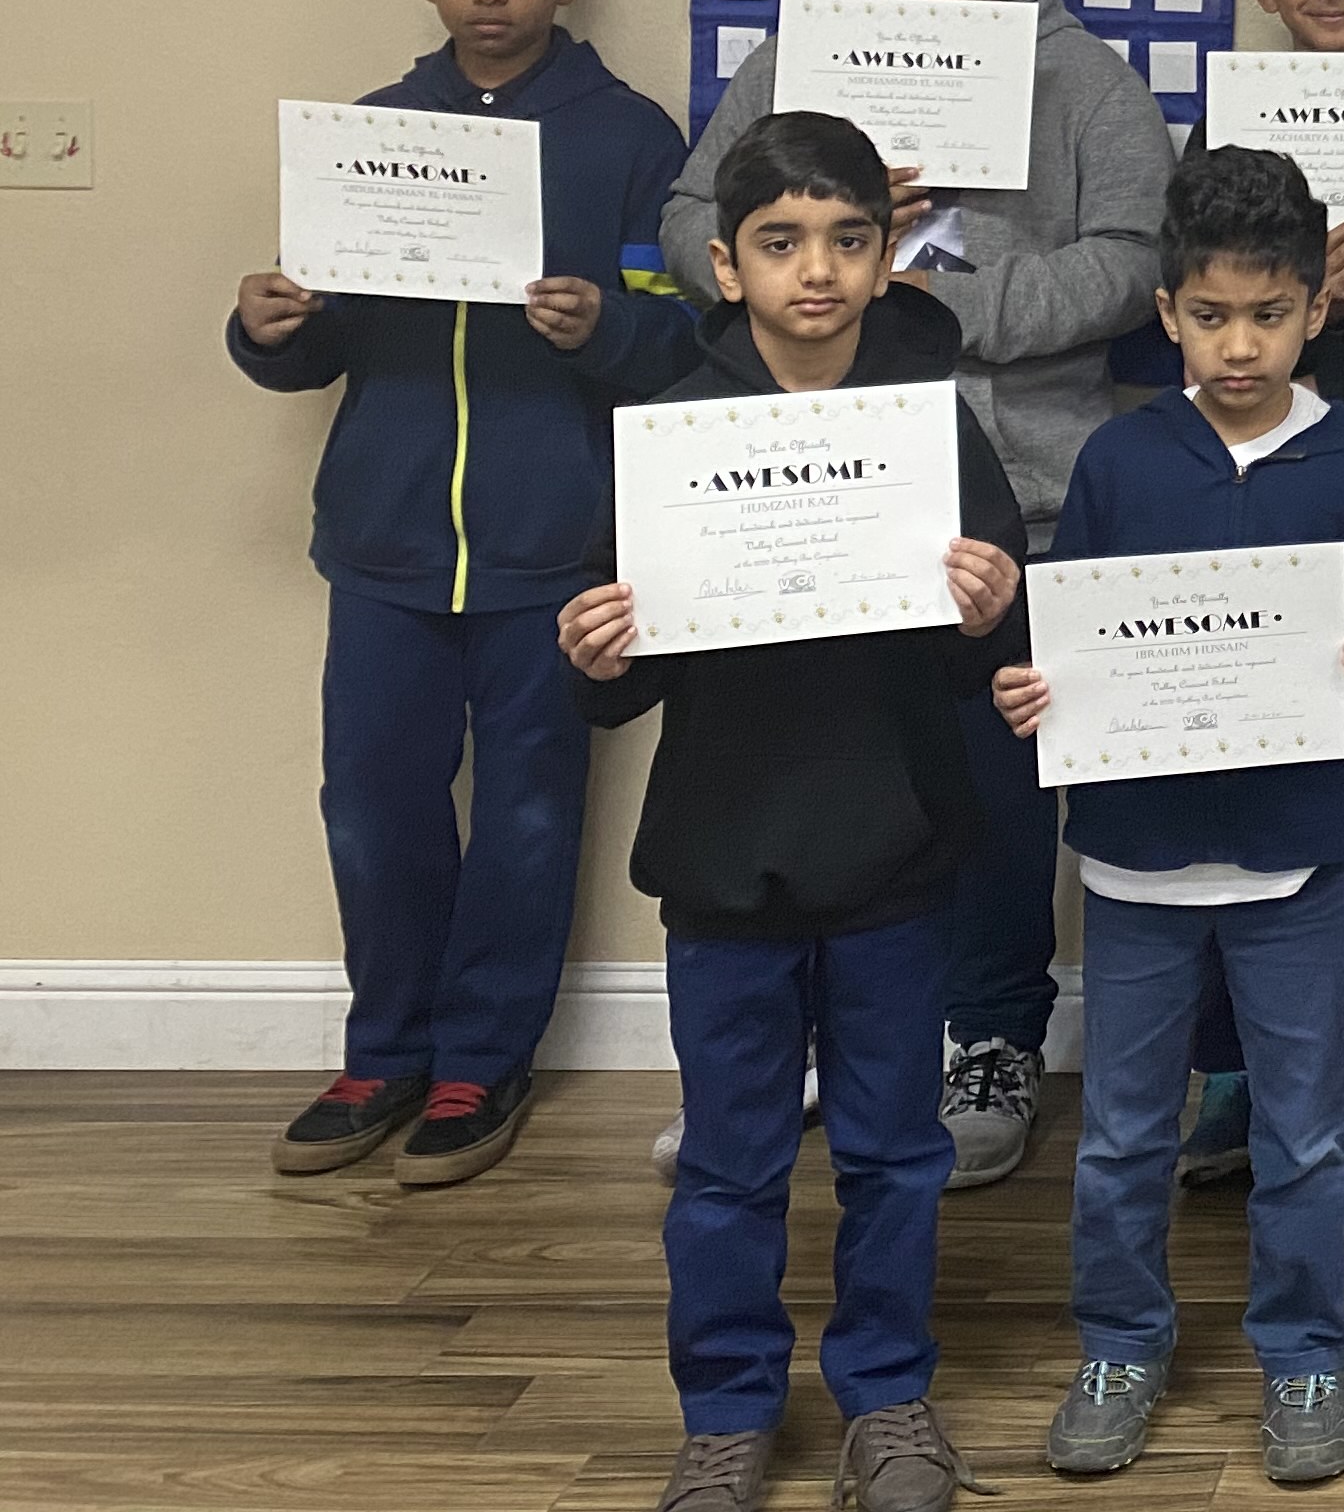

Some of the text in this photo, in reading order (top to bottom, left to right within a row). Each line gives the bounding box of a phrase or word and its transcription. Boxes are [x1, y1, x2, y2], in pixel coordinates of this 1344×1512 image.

[842, 49, 971, 70] AWESOME
[347, 160, 478, 185] AWESOME
[704, 458, 873, 494] AWESOME
[740, 495, 839, 514] HUMZAH KAZI
[1111, 610, 1269, 640] AWESOME
[1135, 641, 1248, 660] IBRAHIM HUSSAIN
